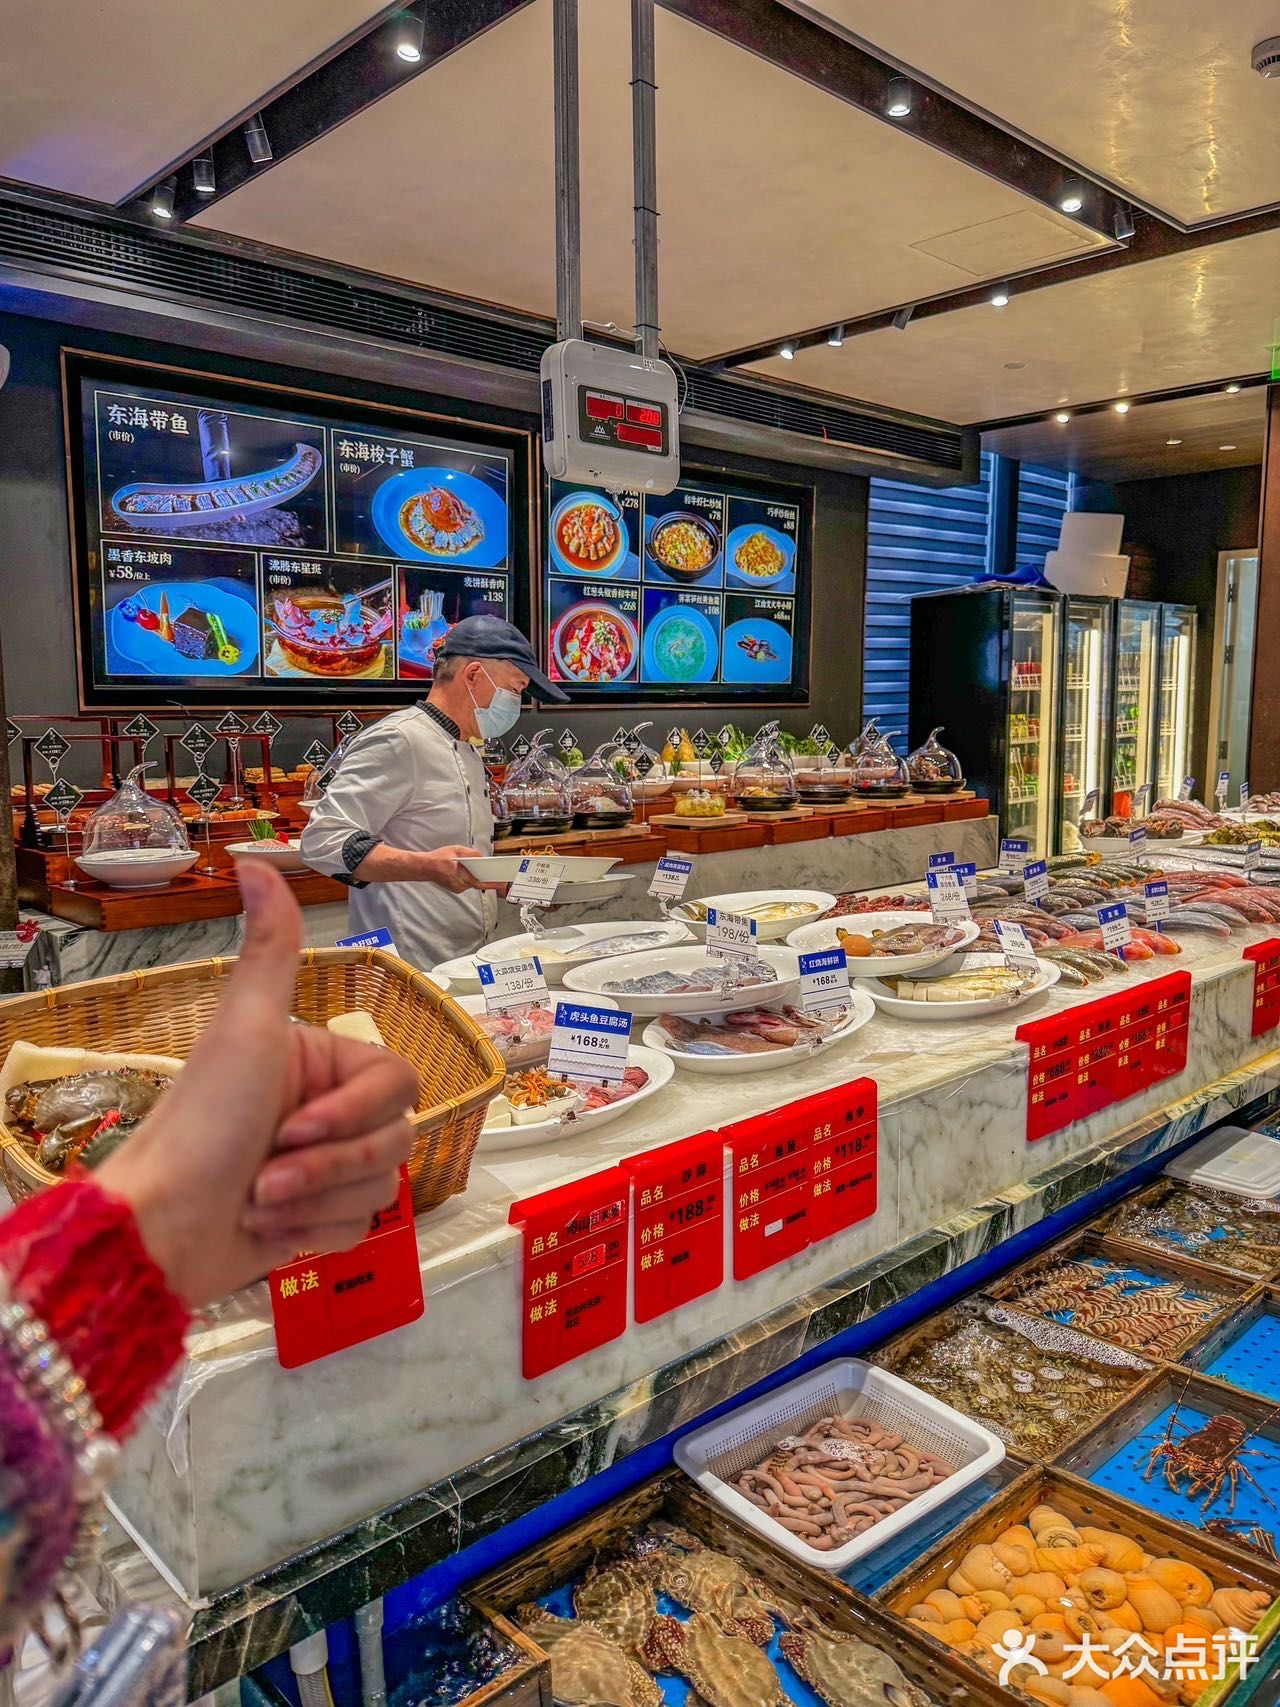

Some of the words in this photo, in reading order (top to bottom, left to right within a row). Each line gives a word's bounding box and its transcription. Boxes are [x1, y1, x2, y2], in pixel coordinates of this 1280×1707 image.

[106, 403, 190, 435] 东海带鱼
[108, 430, 135, 444] (市价)
[338, 439, 415, 468] 东海梭子蟹
[107, 548, 172, 565] 墨香东坡肉
[269, 559, 322, 574] 沸腾东星斑
[483, 591, 504, 602] ¥138
[719, 911, 749, 926] 东海带鱼
[716, 925, 750, 943] 198/份
[505, 978, 534, 991] 138/份
[570, 1011, 628, 1028] 虎头鱼豆腐汤
[1079, 1028, 1091, 1041] 品名
[1033, 1045, 1046, 1059] 品名
[1032, 1072, 1045, 1086] 价格
[1031, 1090, 1045, 1104] 做法
[813, 1123, 832, 1142] 品名
[738, 1153, 760, 1173] 品名
[813, 1156, 832, 1175] 价格
[640, 1184, 664, 1207] 品名
[813, 1179, 832, 1198] 做法
[739, 1188, 760, 1209] 价格
[739, 1212, 760, 1233] 做法
[531, 1230, 559, 1256] 品名
[640, 1222, 665, 1245] 价格
[640, 1248, 665, 1271] 做法
[279, 1269, 320, 1299] 做法
[530, 1271, 559, 1296] 价格
[529, 1299, 558, 1324] 做法
